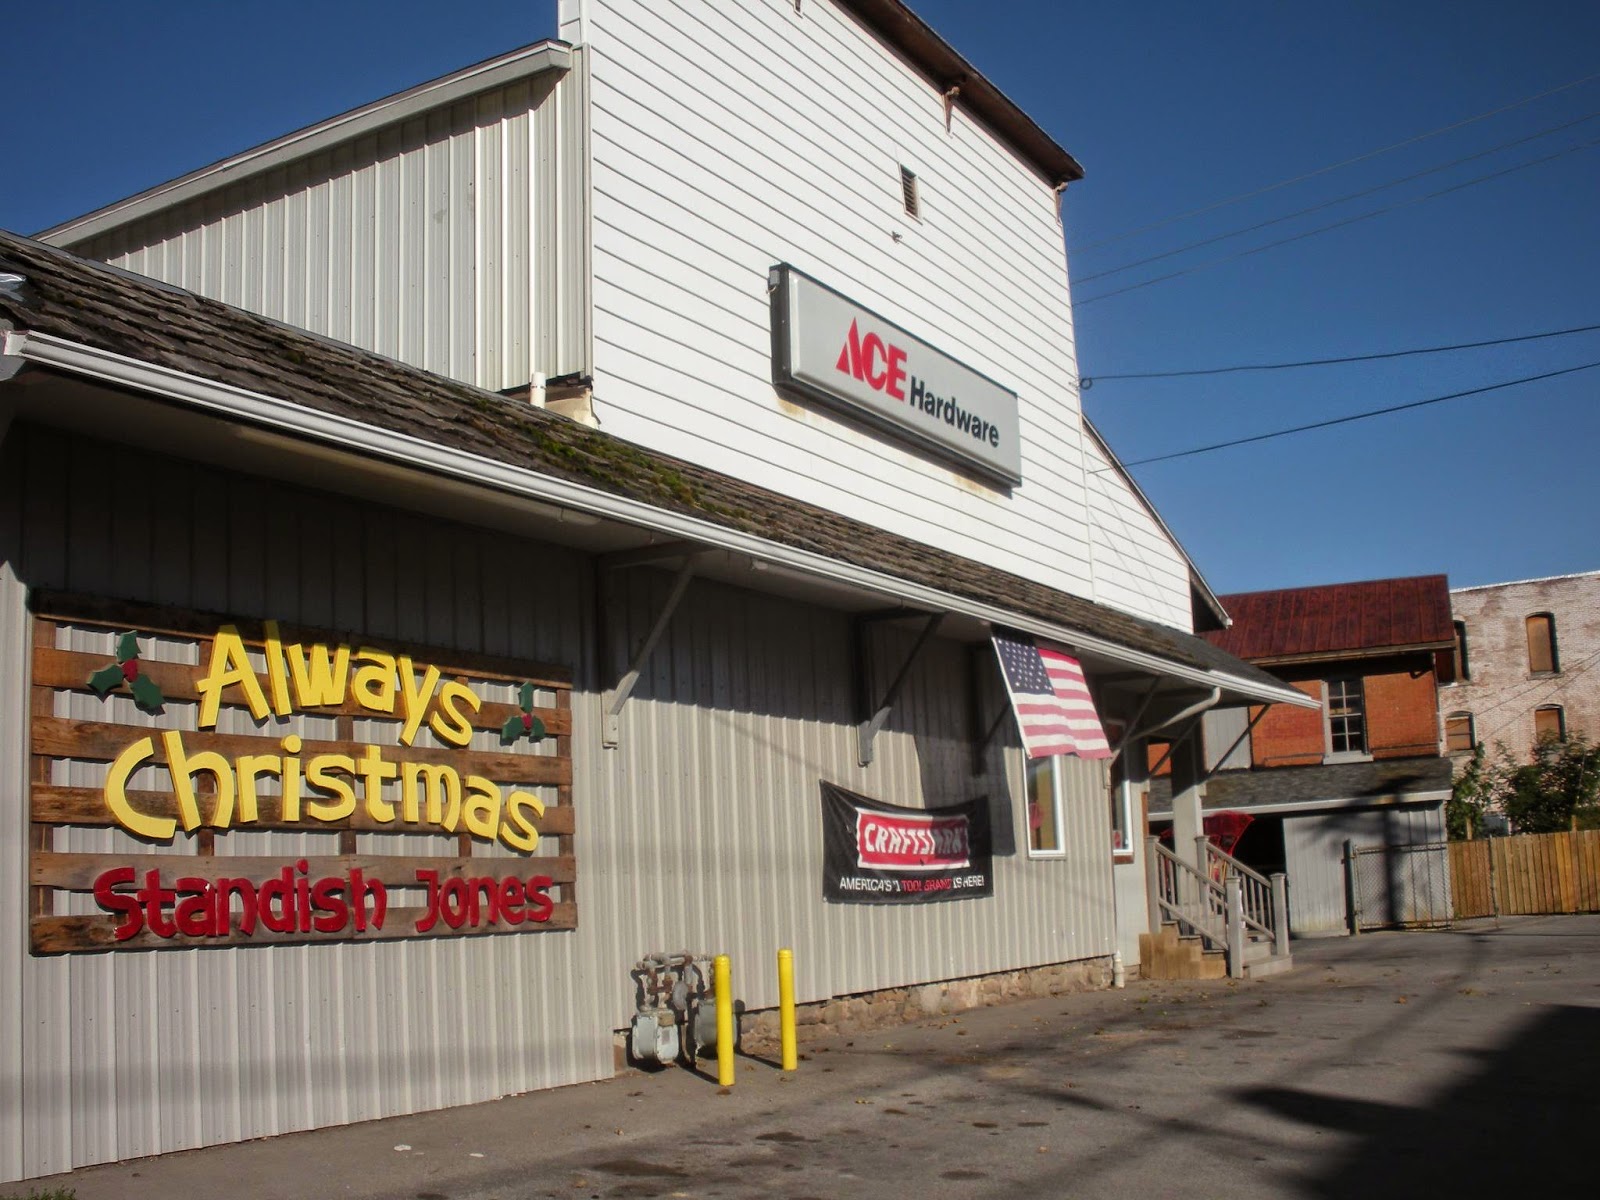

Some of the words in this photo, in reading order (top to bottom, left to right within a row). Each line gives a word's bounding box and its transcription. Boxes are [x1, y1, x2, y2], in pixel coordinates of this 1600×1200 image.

[836, 317, 907, 401] ACE
[909, 375, 999, 448] Hardware
[196, 620, 481, 747] Always
[104, 730, 545, 852] Christmas
[93, 859, 388, 941] Standish
[415, 868, 554, 933] Jones
[839, 876, 892, 892] AMERICA'S
[953, 877, 962, 889] IS
[963, 875, 984, 888] HERE!
